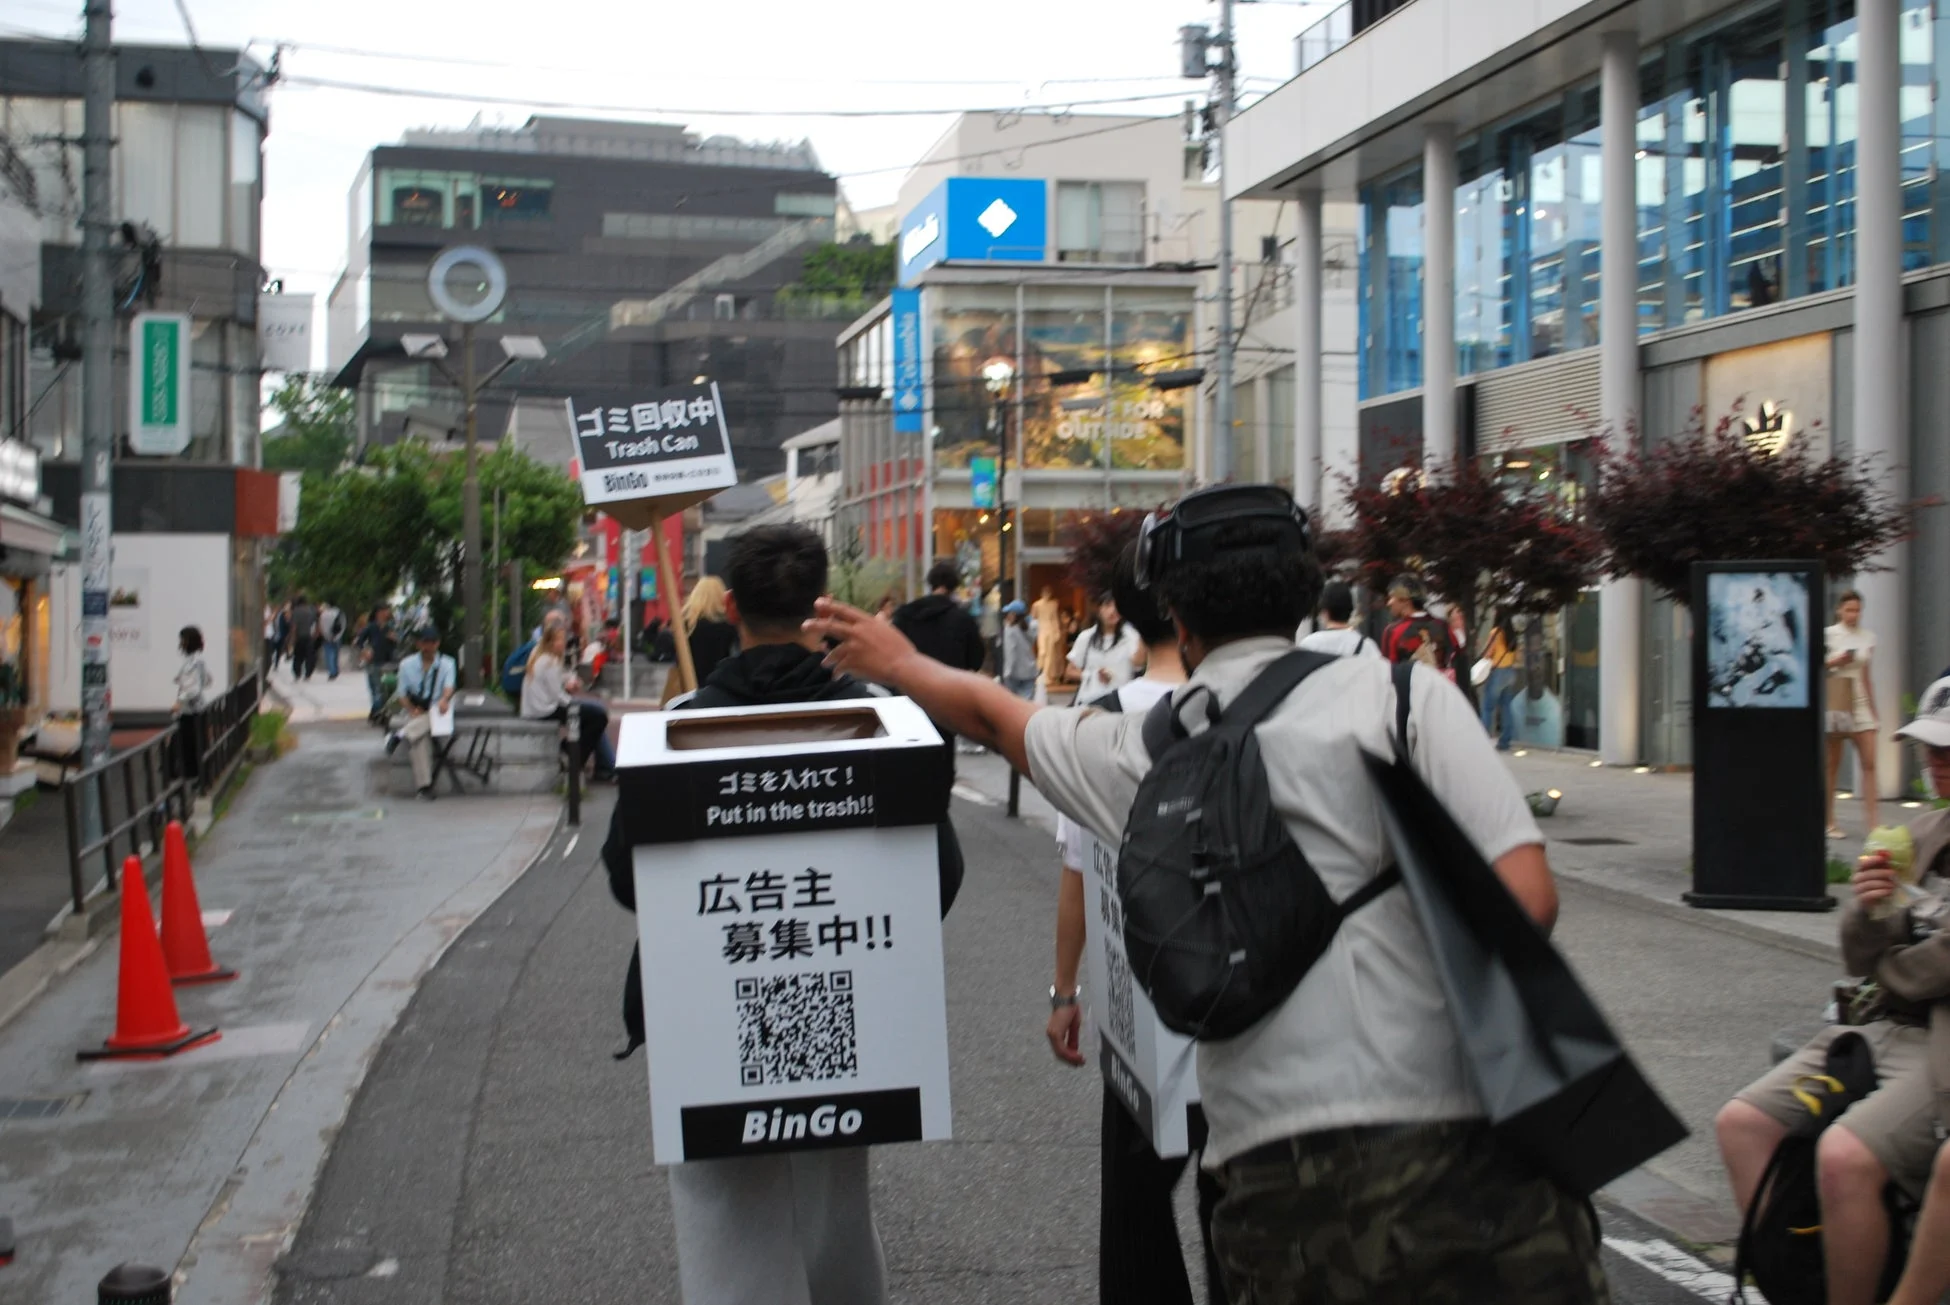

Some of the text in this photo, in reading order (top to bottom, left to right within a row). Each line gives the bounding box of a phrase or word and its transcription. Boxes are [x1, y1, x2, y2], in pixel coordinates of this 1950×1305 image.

[577, 396, 715, 437] ゴミ回収中
[605, 435, 699, 459] Trash Can
[707, 795, 874, 826] Put in the trash!!
[697, 867, 836, 916] 広告主
[721, 914, 893, 964] 募集中!!
[742, 1104, 862, 1143] BinGo
